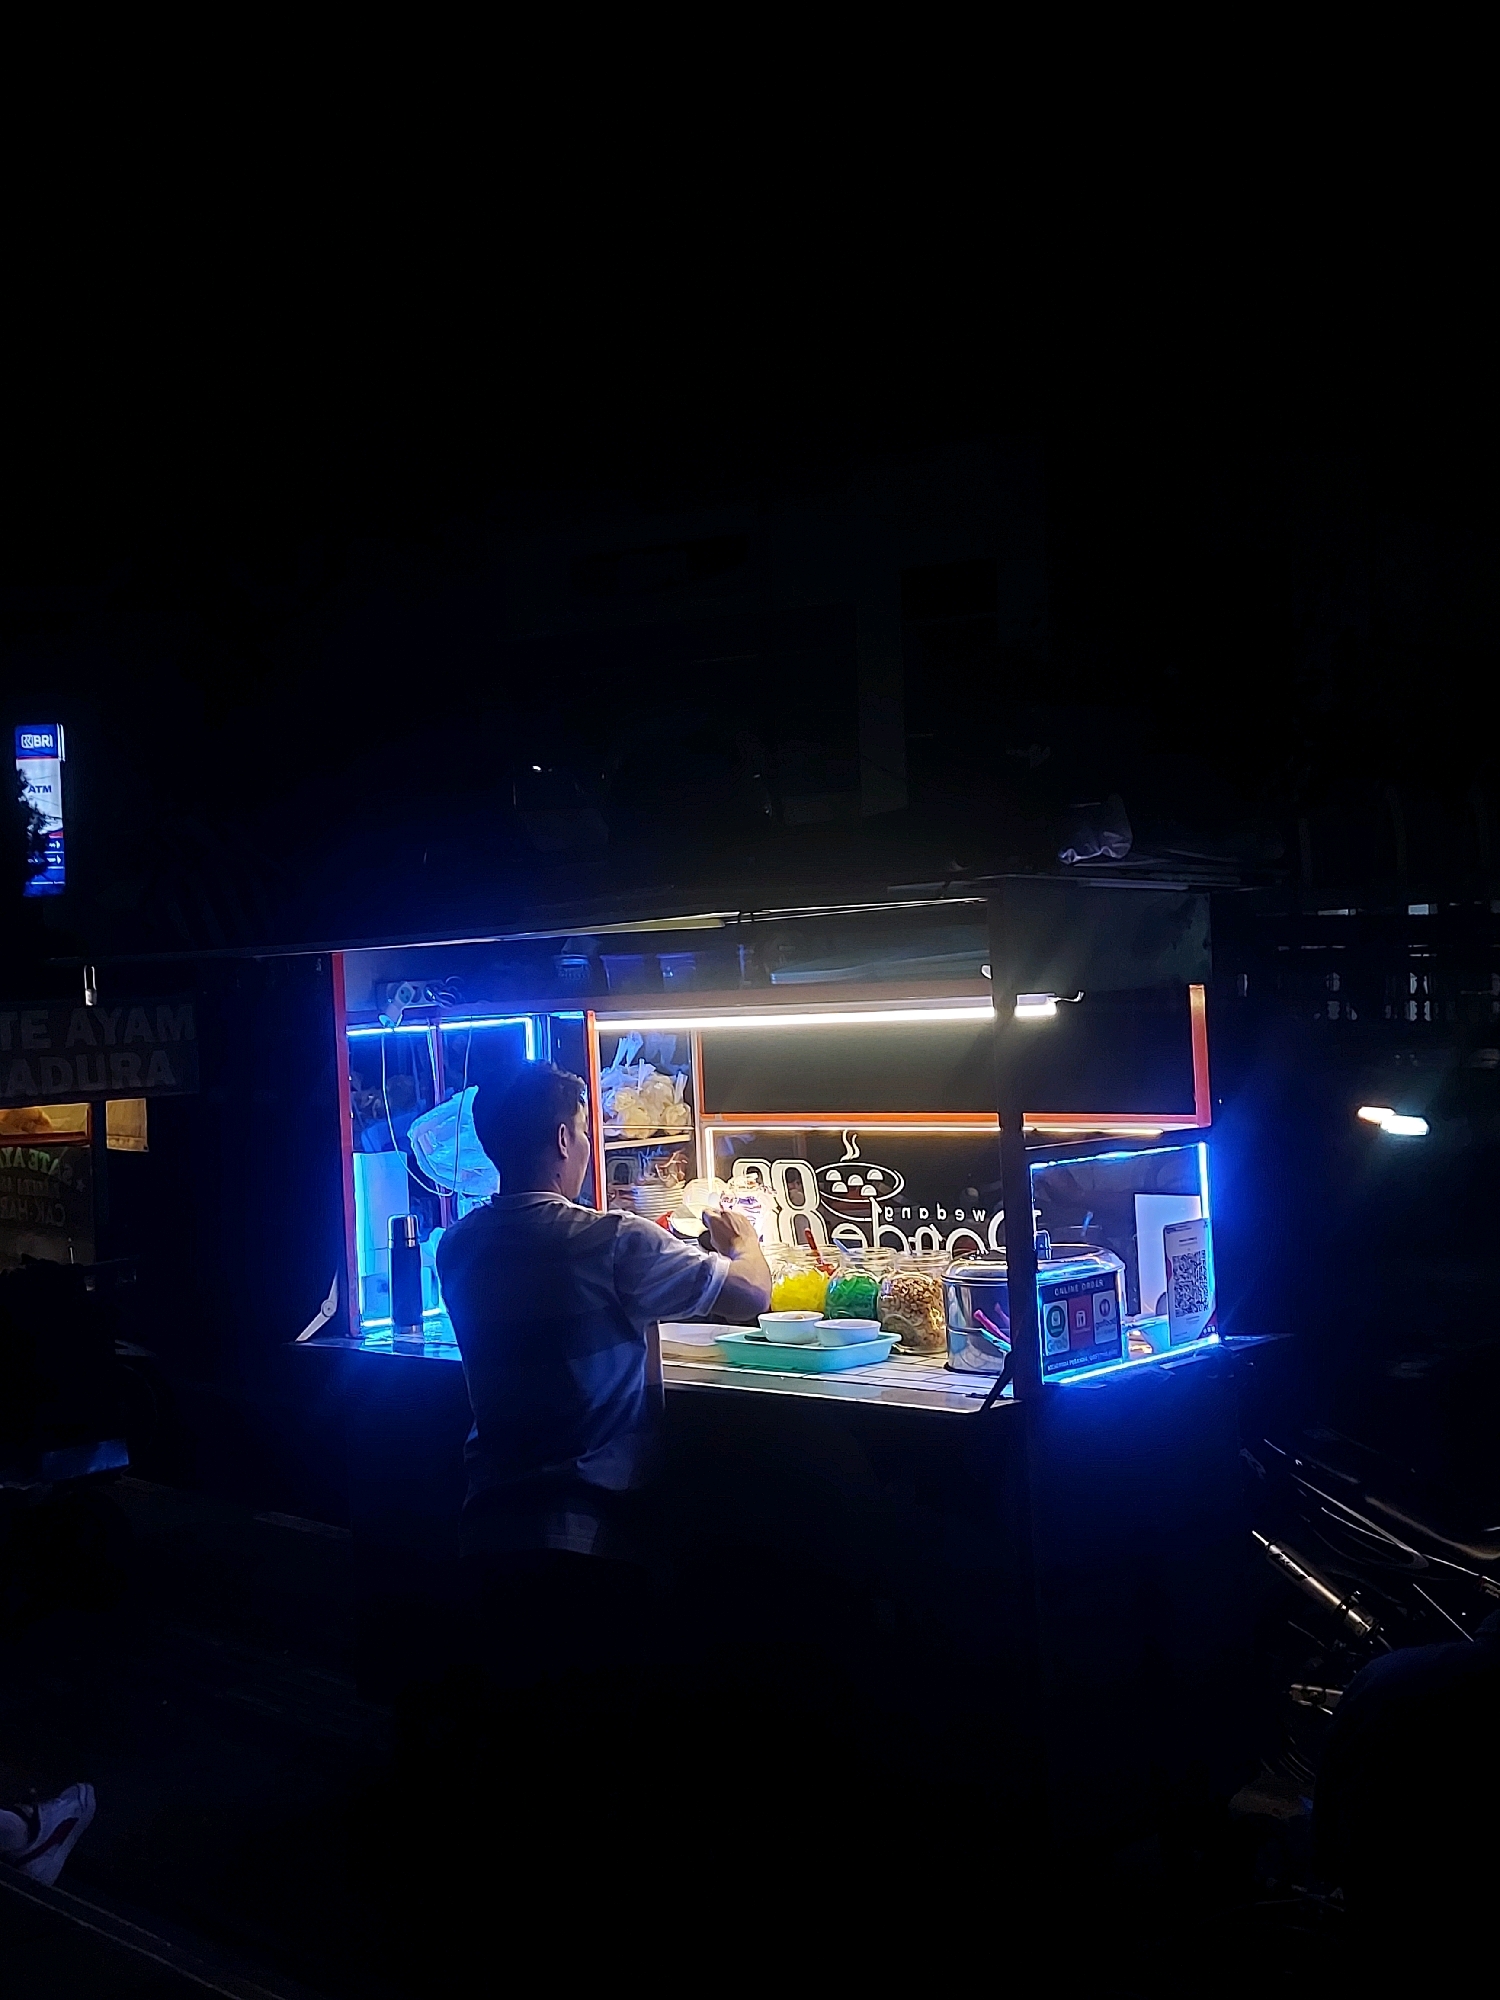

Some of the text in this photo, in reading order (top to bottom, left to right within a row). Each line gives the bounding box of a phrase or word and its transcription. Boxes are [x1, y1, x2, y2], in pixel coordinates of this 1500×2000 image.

[34, 734, 53, 748] BRI
[28, 784, 52, 793] ATM
[66, 1004, 195, 1047] AYAM
[1054, 1279, 1104, 1296] ONLINE ORDER
